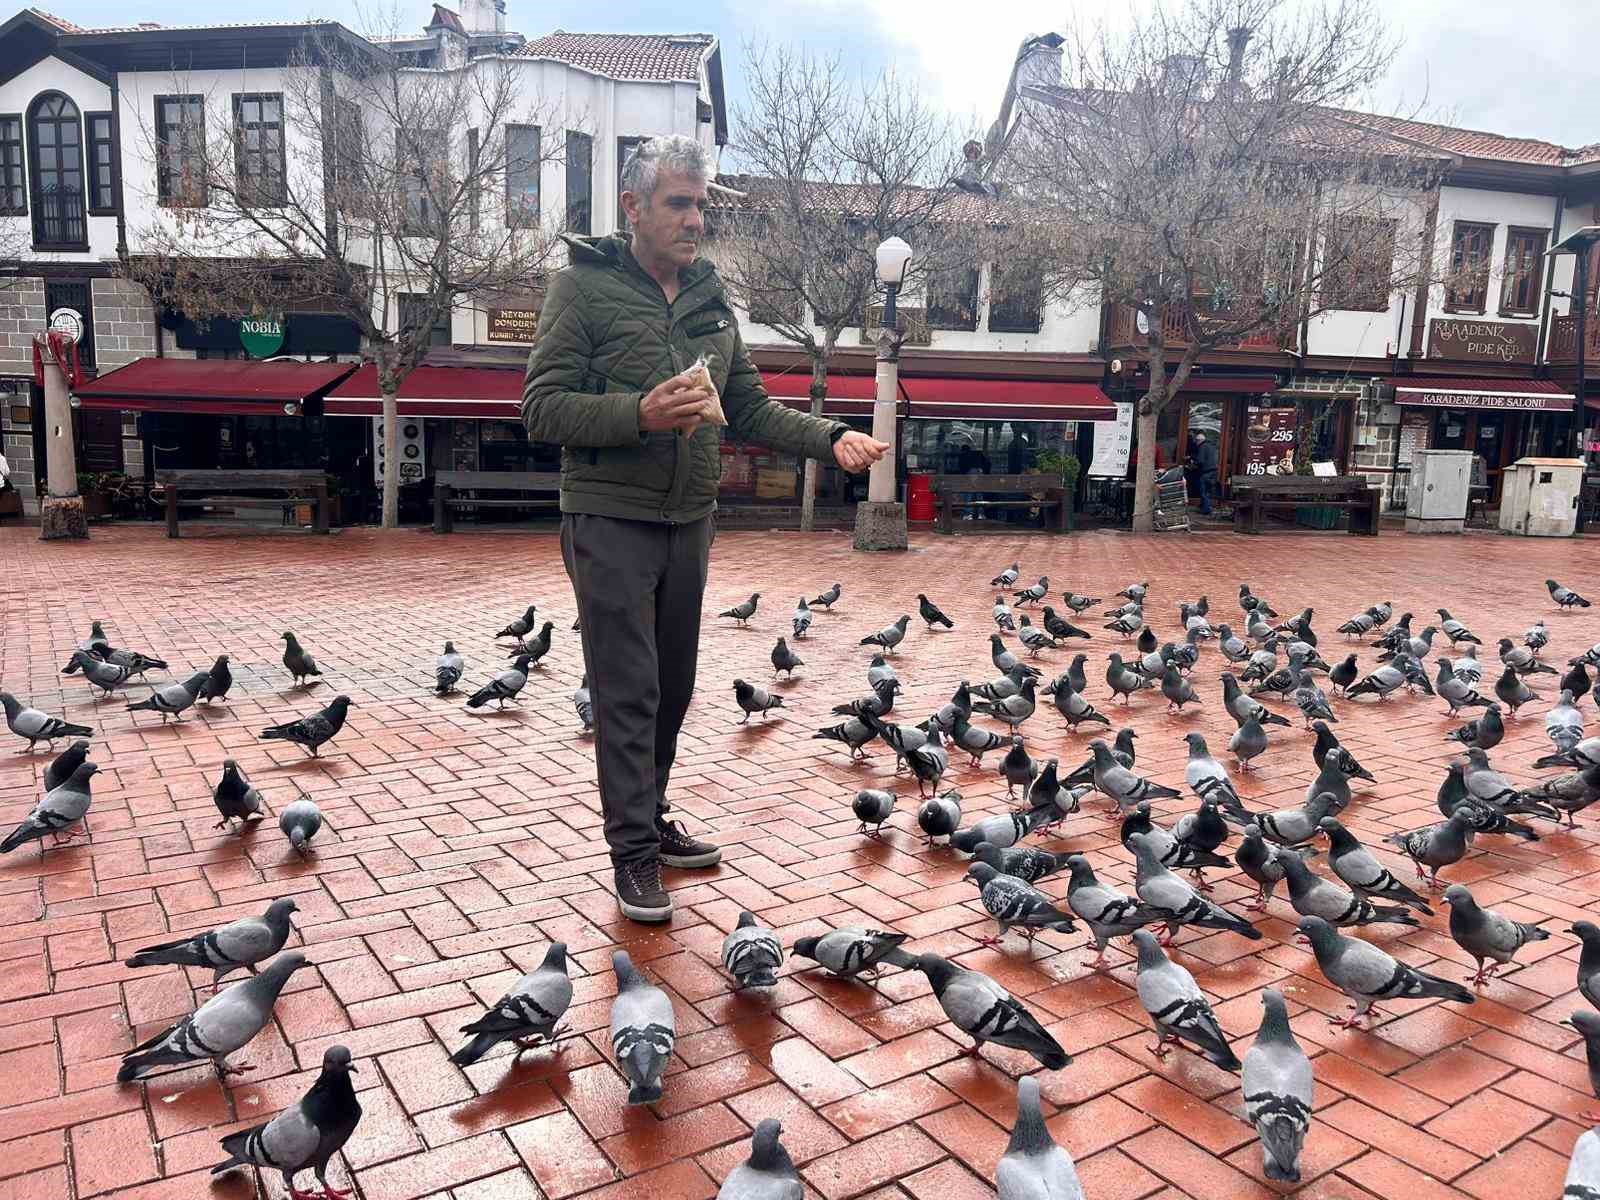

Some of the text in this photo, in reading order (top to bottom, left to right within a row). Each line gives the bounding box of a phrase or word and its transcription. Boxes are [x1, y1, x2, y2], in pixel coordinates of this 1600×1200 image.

[242, 320, 281, 334] NOBIA
[495, 319, 538, 328] DONDURM
[1506, 398, 1546, 408] SALONU
[1271, 430, 1293, 442] 295
[1246, 462, 1266, 475] 195
